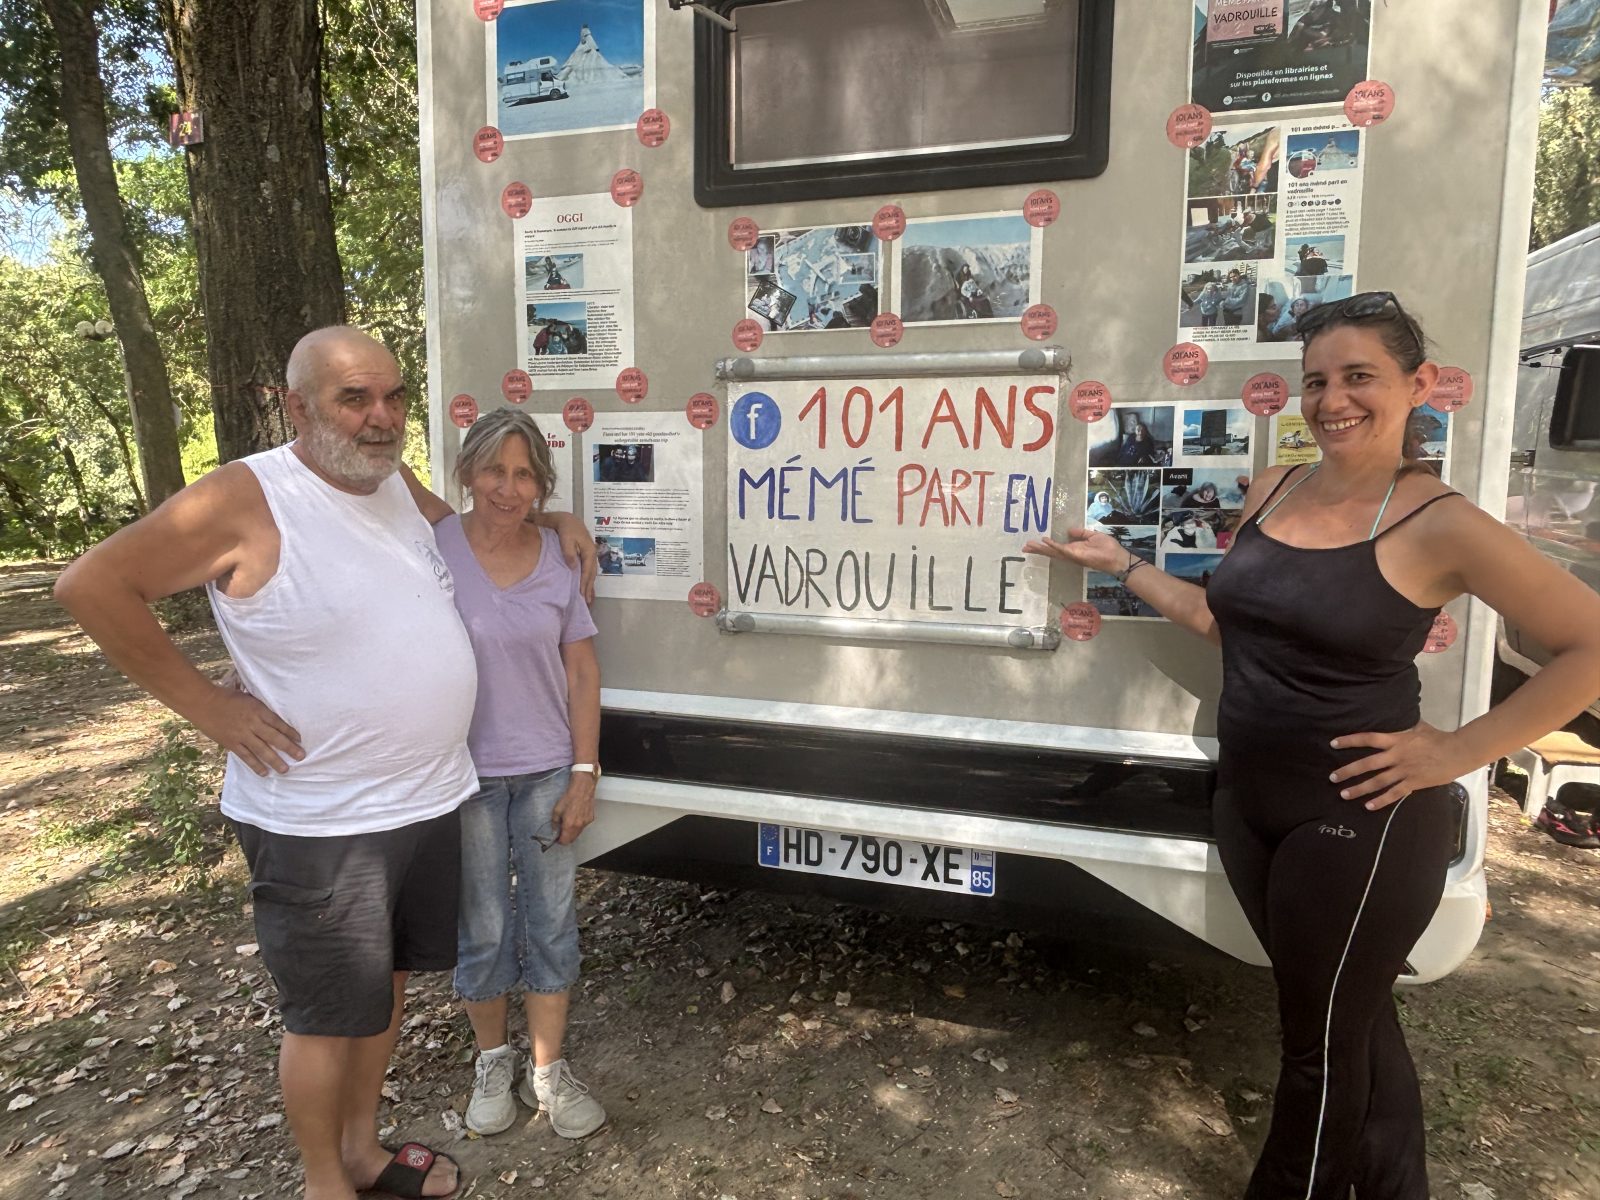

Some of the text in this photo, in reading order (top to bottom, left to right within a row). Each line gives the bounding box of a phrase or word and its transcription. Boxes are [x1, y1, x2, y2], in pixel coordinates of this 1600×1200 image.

[1214, 7, 1278, 23] VADROUILLE
[1236, 70, 1273, 79] Disponible
[1285, 66, 1318, 74] librairies
[1253, 77, 1297, 87] plateformes
[1310, 73, 1333, 81] lignes
[1188, 112, 1202, 120] ANS
[557, 213, 583, 223] OGGI
[799, 385, 1056, 452] 101 ANS
[738, 455, 1052, 534] MÉMÉ PART EN
[594, 517, 611, 525] TN
[766, 846, 773, 856] F
[783, 827, 963, 885] HD-790-XE
[972, 870, 991, 888] 85
